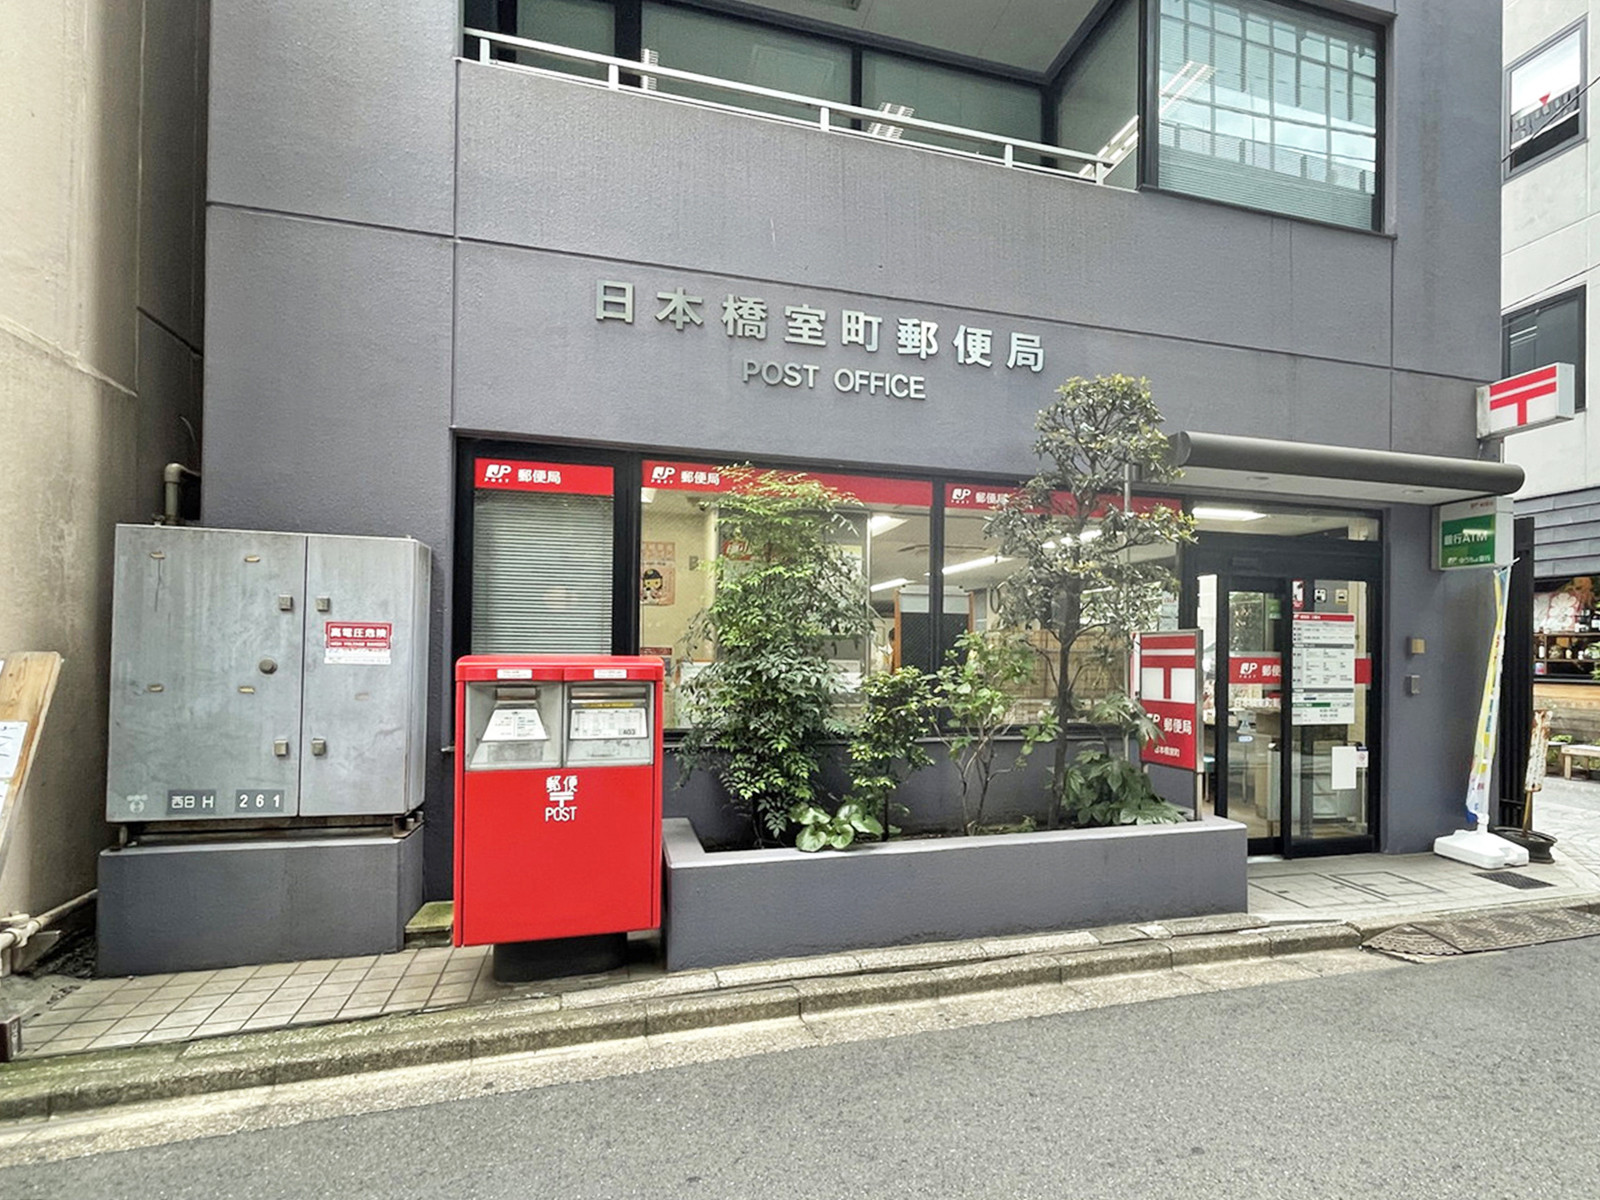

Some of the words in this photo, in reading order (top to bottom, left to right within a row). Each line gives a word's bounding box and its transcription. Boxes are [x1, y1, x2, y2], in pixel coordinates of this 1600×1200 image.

[595, 279, 1045, 373] 日本橋室町郵便局
[742, 359, 820, 388] POST
[834, 368, 927, 400] OFFICE
[518, 469, 562, 485] 郵便局
[681, 470, 720, 486] 郵便局
[1163, 717, 1192, 735] 郵便局
[546, 775, 578, 792] 郵便
[202, 796, 214, 808] H
[545, 806, 578, 822] POST
